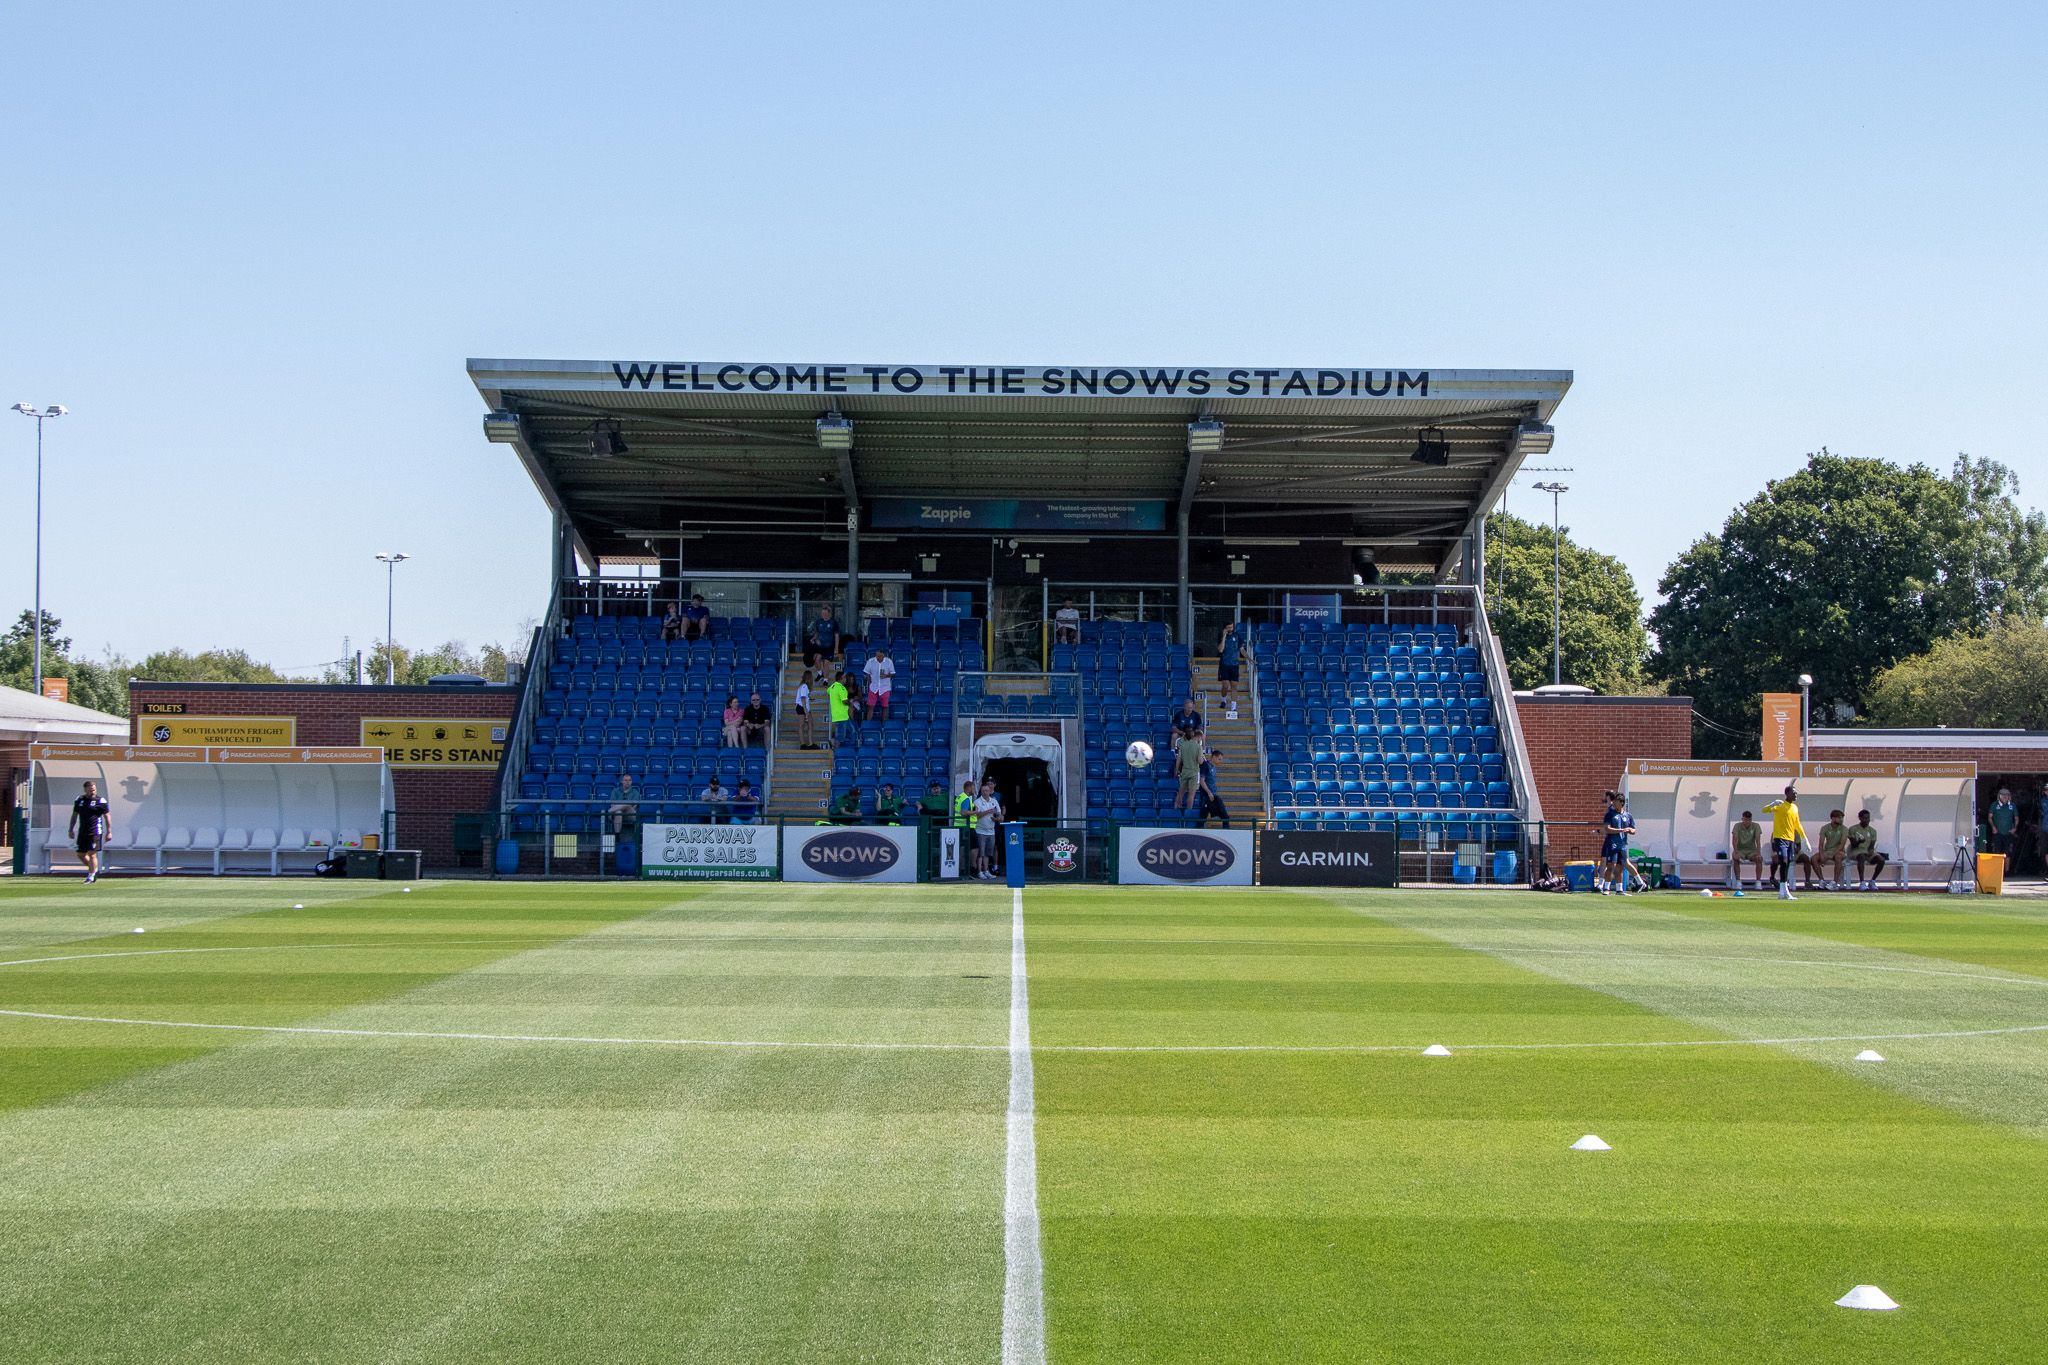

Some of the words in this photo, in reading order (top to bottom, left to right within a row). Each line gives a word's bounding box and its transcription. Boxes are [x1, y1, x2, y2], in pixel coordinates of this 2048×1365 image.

[612, 363, 848, 392] WELCOME
[863, 366, 924, 393] TO
[939, 367, 1025, 394] THE
[1041, 368, 1211, 395] SNOWS
[1226, 370, 1429, 397] STADIUM
[921, 506, 972, 523] Zappie
[1295, 608, 1329, 619] Zappie
[147, 704, 183, 713] TOILETS
[153, 727, 170, 741] sfs
[182, 727, 245, 735] SOUTHAMPTON
[384, 749, 405, 761] HE
[409, 748, 443, 762] SFS
[448, 748, 503, 762] STAND
[665, 826, 757, 844] PARKWAY
[662, 846, 699, 863] CAR
[704, 847, 757, 864] SALES
[809, 846, 892, 863] SNOWS
[1145, 848, 1228, 866] SNOWS
[648, 868, 770, 879] www.parkwaycarsales.co.uk
